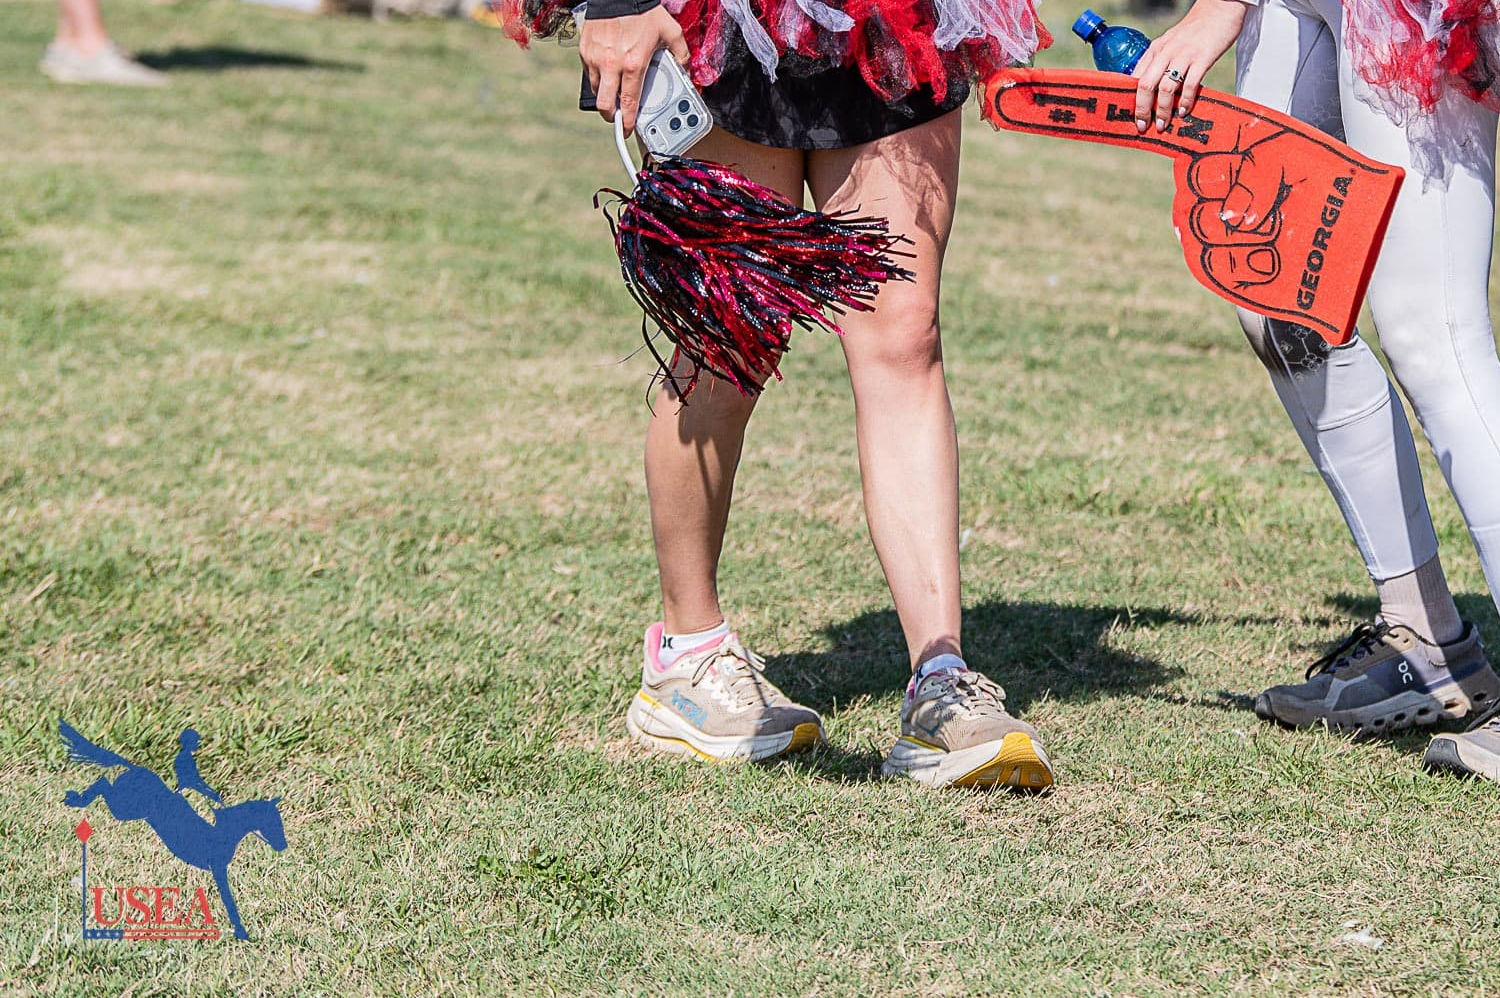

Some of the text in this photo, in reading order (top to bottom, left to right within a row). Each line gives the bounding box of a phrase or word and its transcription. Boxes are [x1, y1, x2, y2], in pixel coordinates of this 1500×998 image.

[1033, 93, 1097, 124] #1
[1106, 103, 1214, 144] FN
[1296, 176, 1353, 310] GEORGIA
